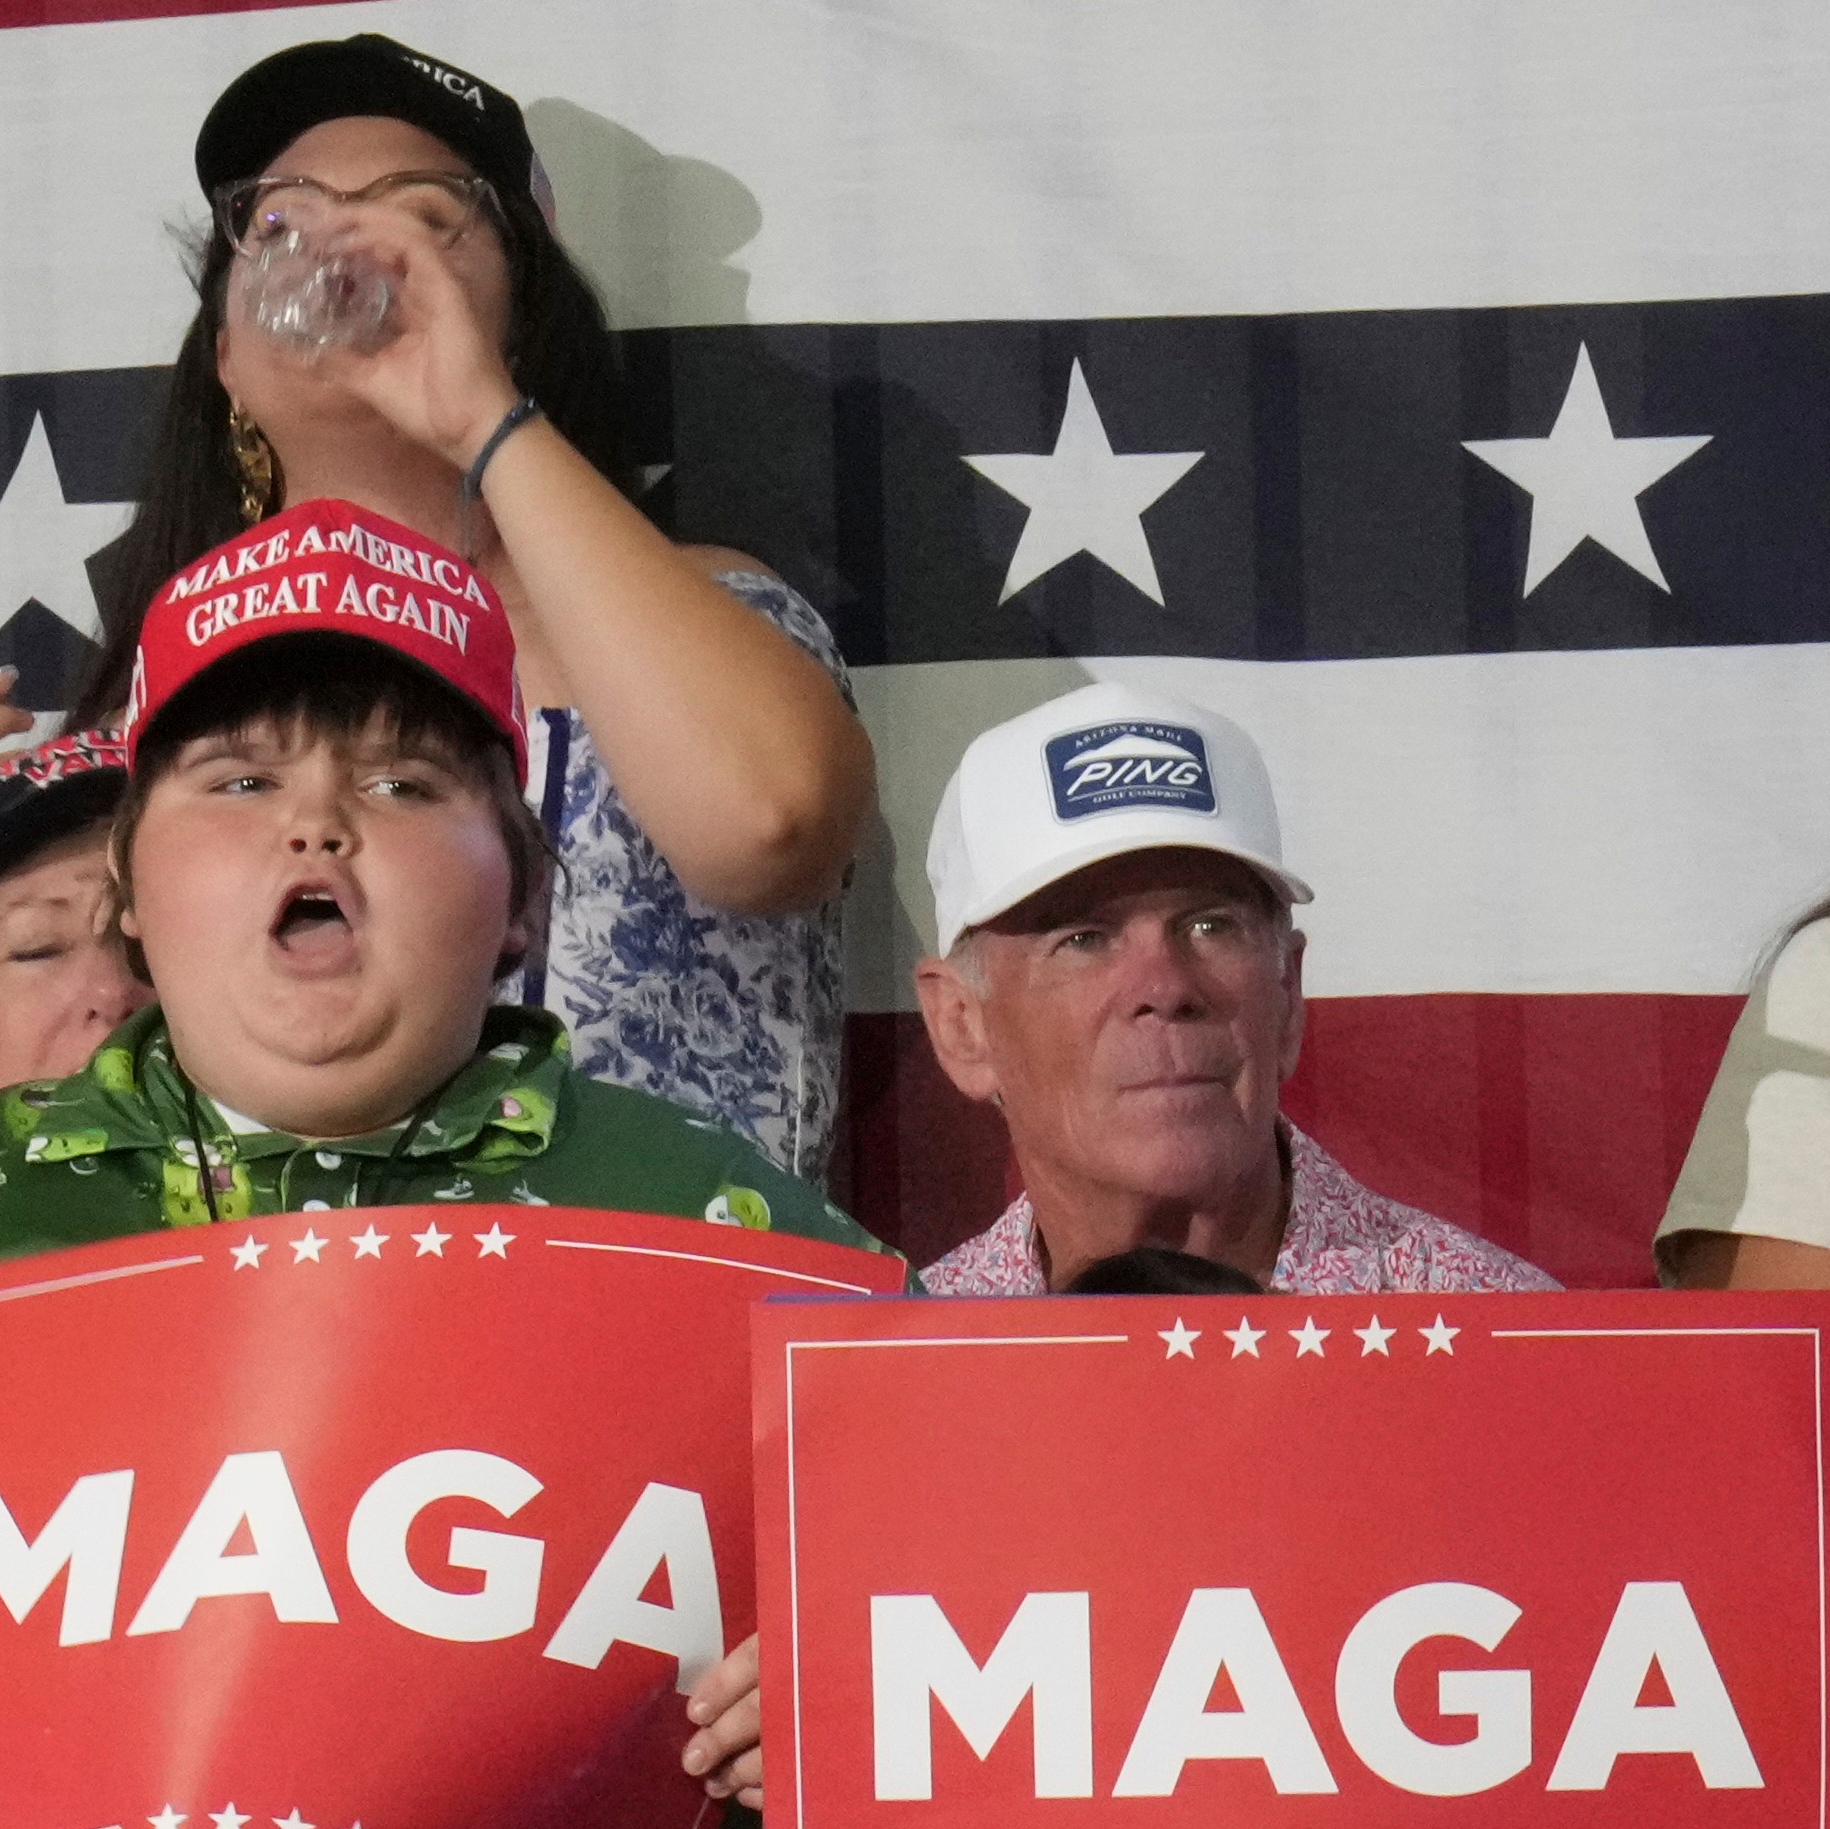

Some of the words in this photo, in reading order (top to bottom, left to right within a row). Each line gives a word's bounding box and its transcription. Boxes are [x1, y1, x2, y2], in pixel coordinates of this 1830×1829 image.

[165, 528, 290, 604] MAKE
[293, 523, 491, 612] AMERICA
[185, 571, 327, 648] GREAT
[334, 573, 471, 656] AGAIN
[1066, 758, 1203, 796] PING
[869, 1580, 1766, 1802] MAGA
